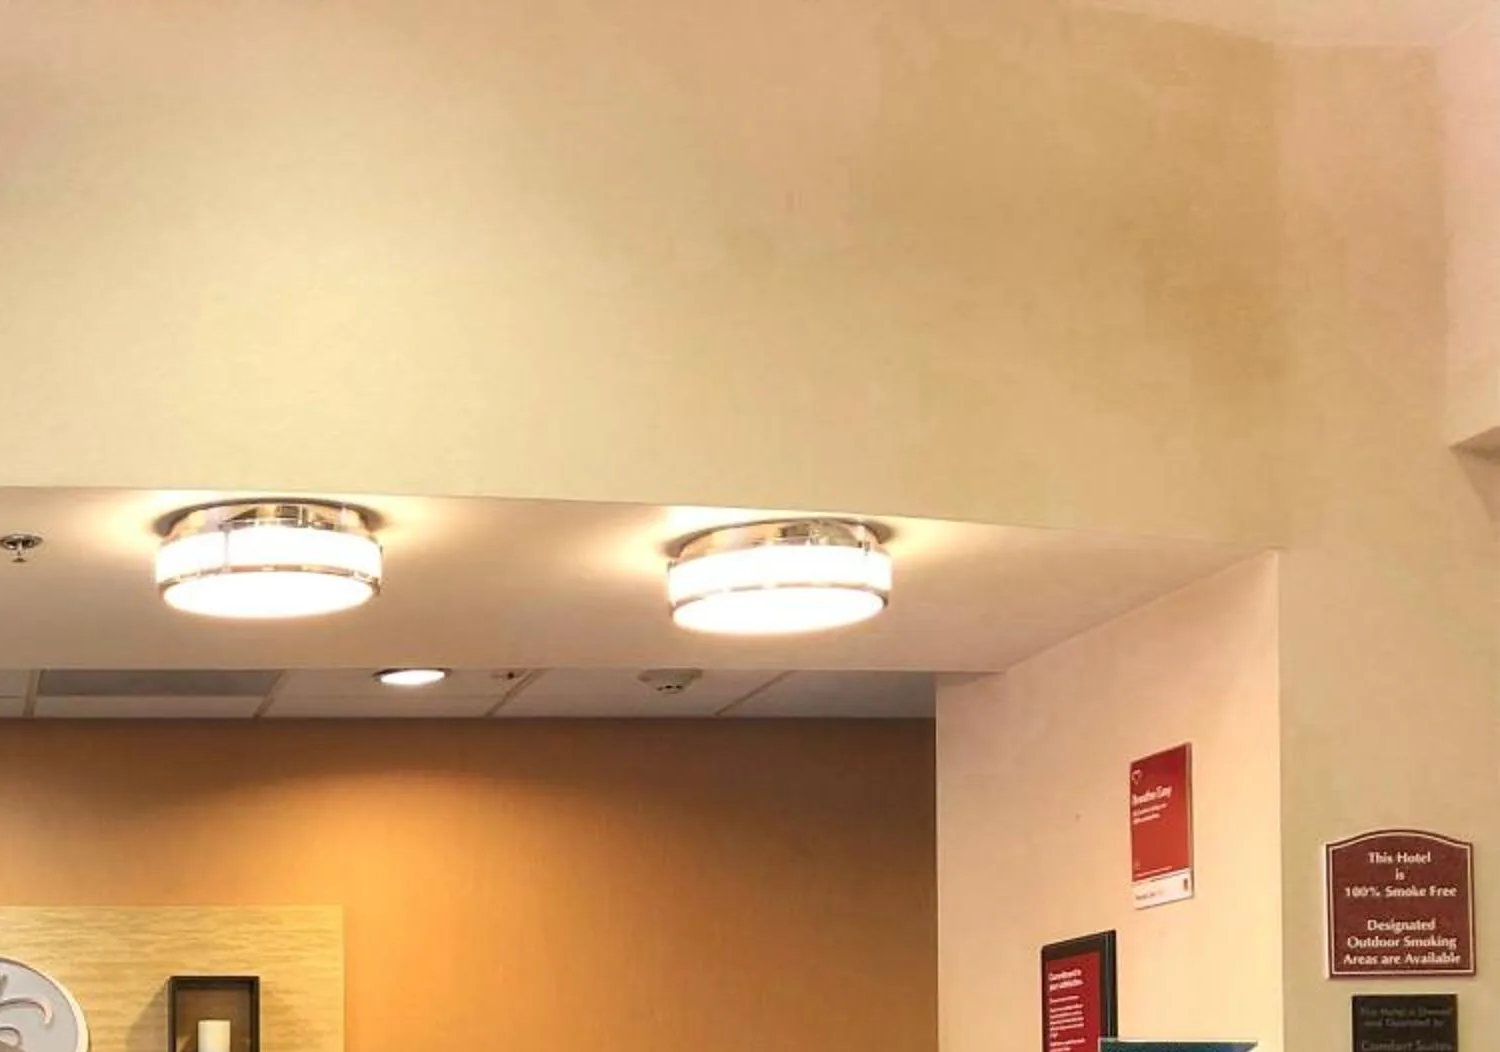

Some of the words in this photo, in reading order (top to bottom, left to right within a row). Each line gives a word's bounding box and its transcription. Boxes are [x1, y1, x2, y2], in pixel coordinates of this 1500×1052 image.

[1368, 852, 1393, 864] This
[1397, 851, 1432, 864] Hotel
[1395, 868, 1405, 880] is
[1346, 886, 1381, 897] 100%
[1385, 885, 1426, 897] Smoke
[1429, 885, 1457, 897] Free
[1367, 918, 1436, 934] Designated
[1347, 936, 1400, 949] Outdoor
[1403, 934, 1457, 951] Smoking
[1343, 954, 1378, 965] Areas
[1380, 956, 1401, 965] are
[1404, 952, 1461, 966] Available
